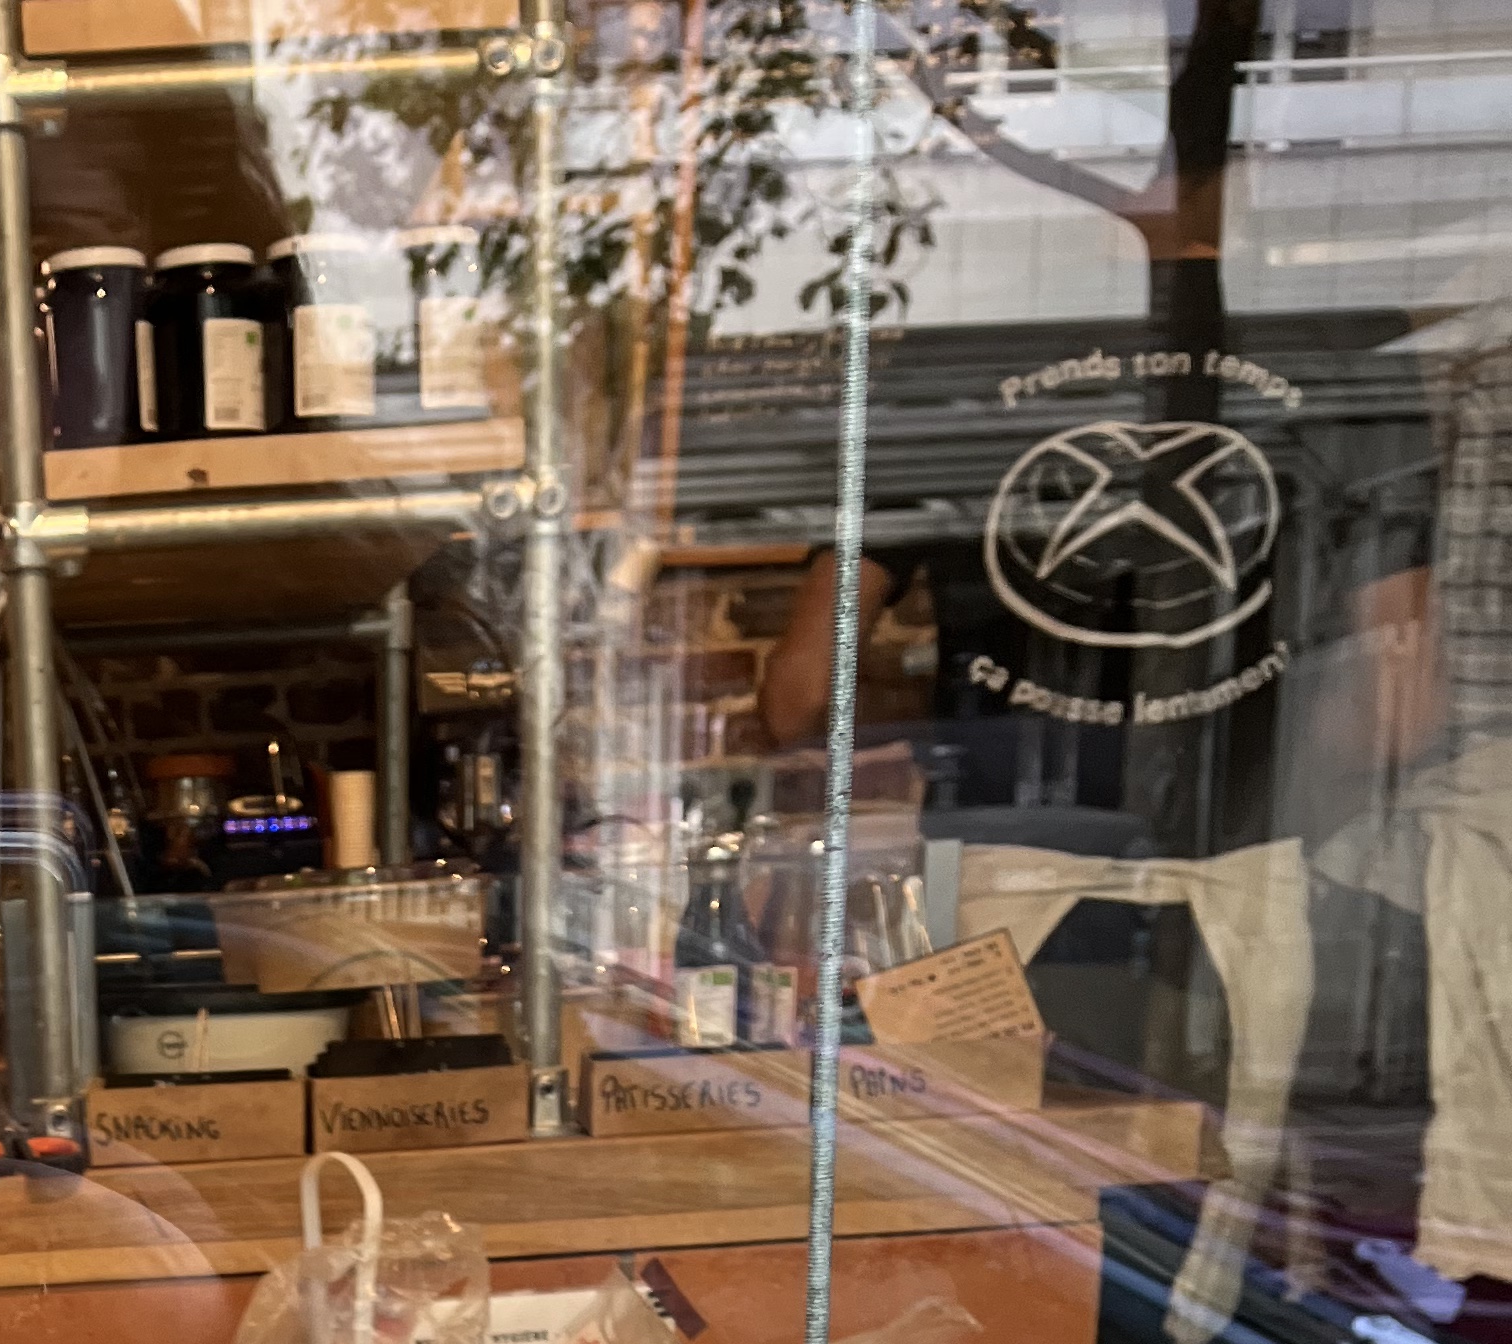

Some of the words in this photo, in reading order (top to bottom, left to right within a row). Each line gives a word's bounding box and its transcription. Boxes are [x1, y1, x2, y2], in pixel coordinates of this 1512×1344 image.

[998, 349, 1121, 410] Prends
[1132, 352, 1192, 377] ton
[1202, 349, 1303, 408] temps
[1009, 679, 1124, 725] pousse
[94, 1111, 221, 1147] SNACKING
[318, 1099, 489, 1136] VIENNOISERIES
